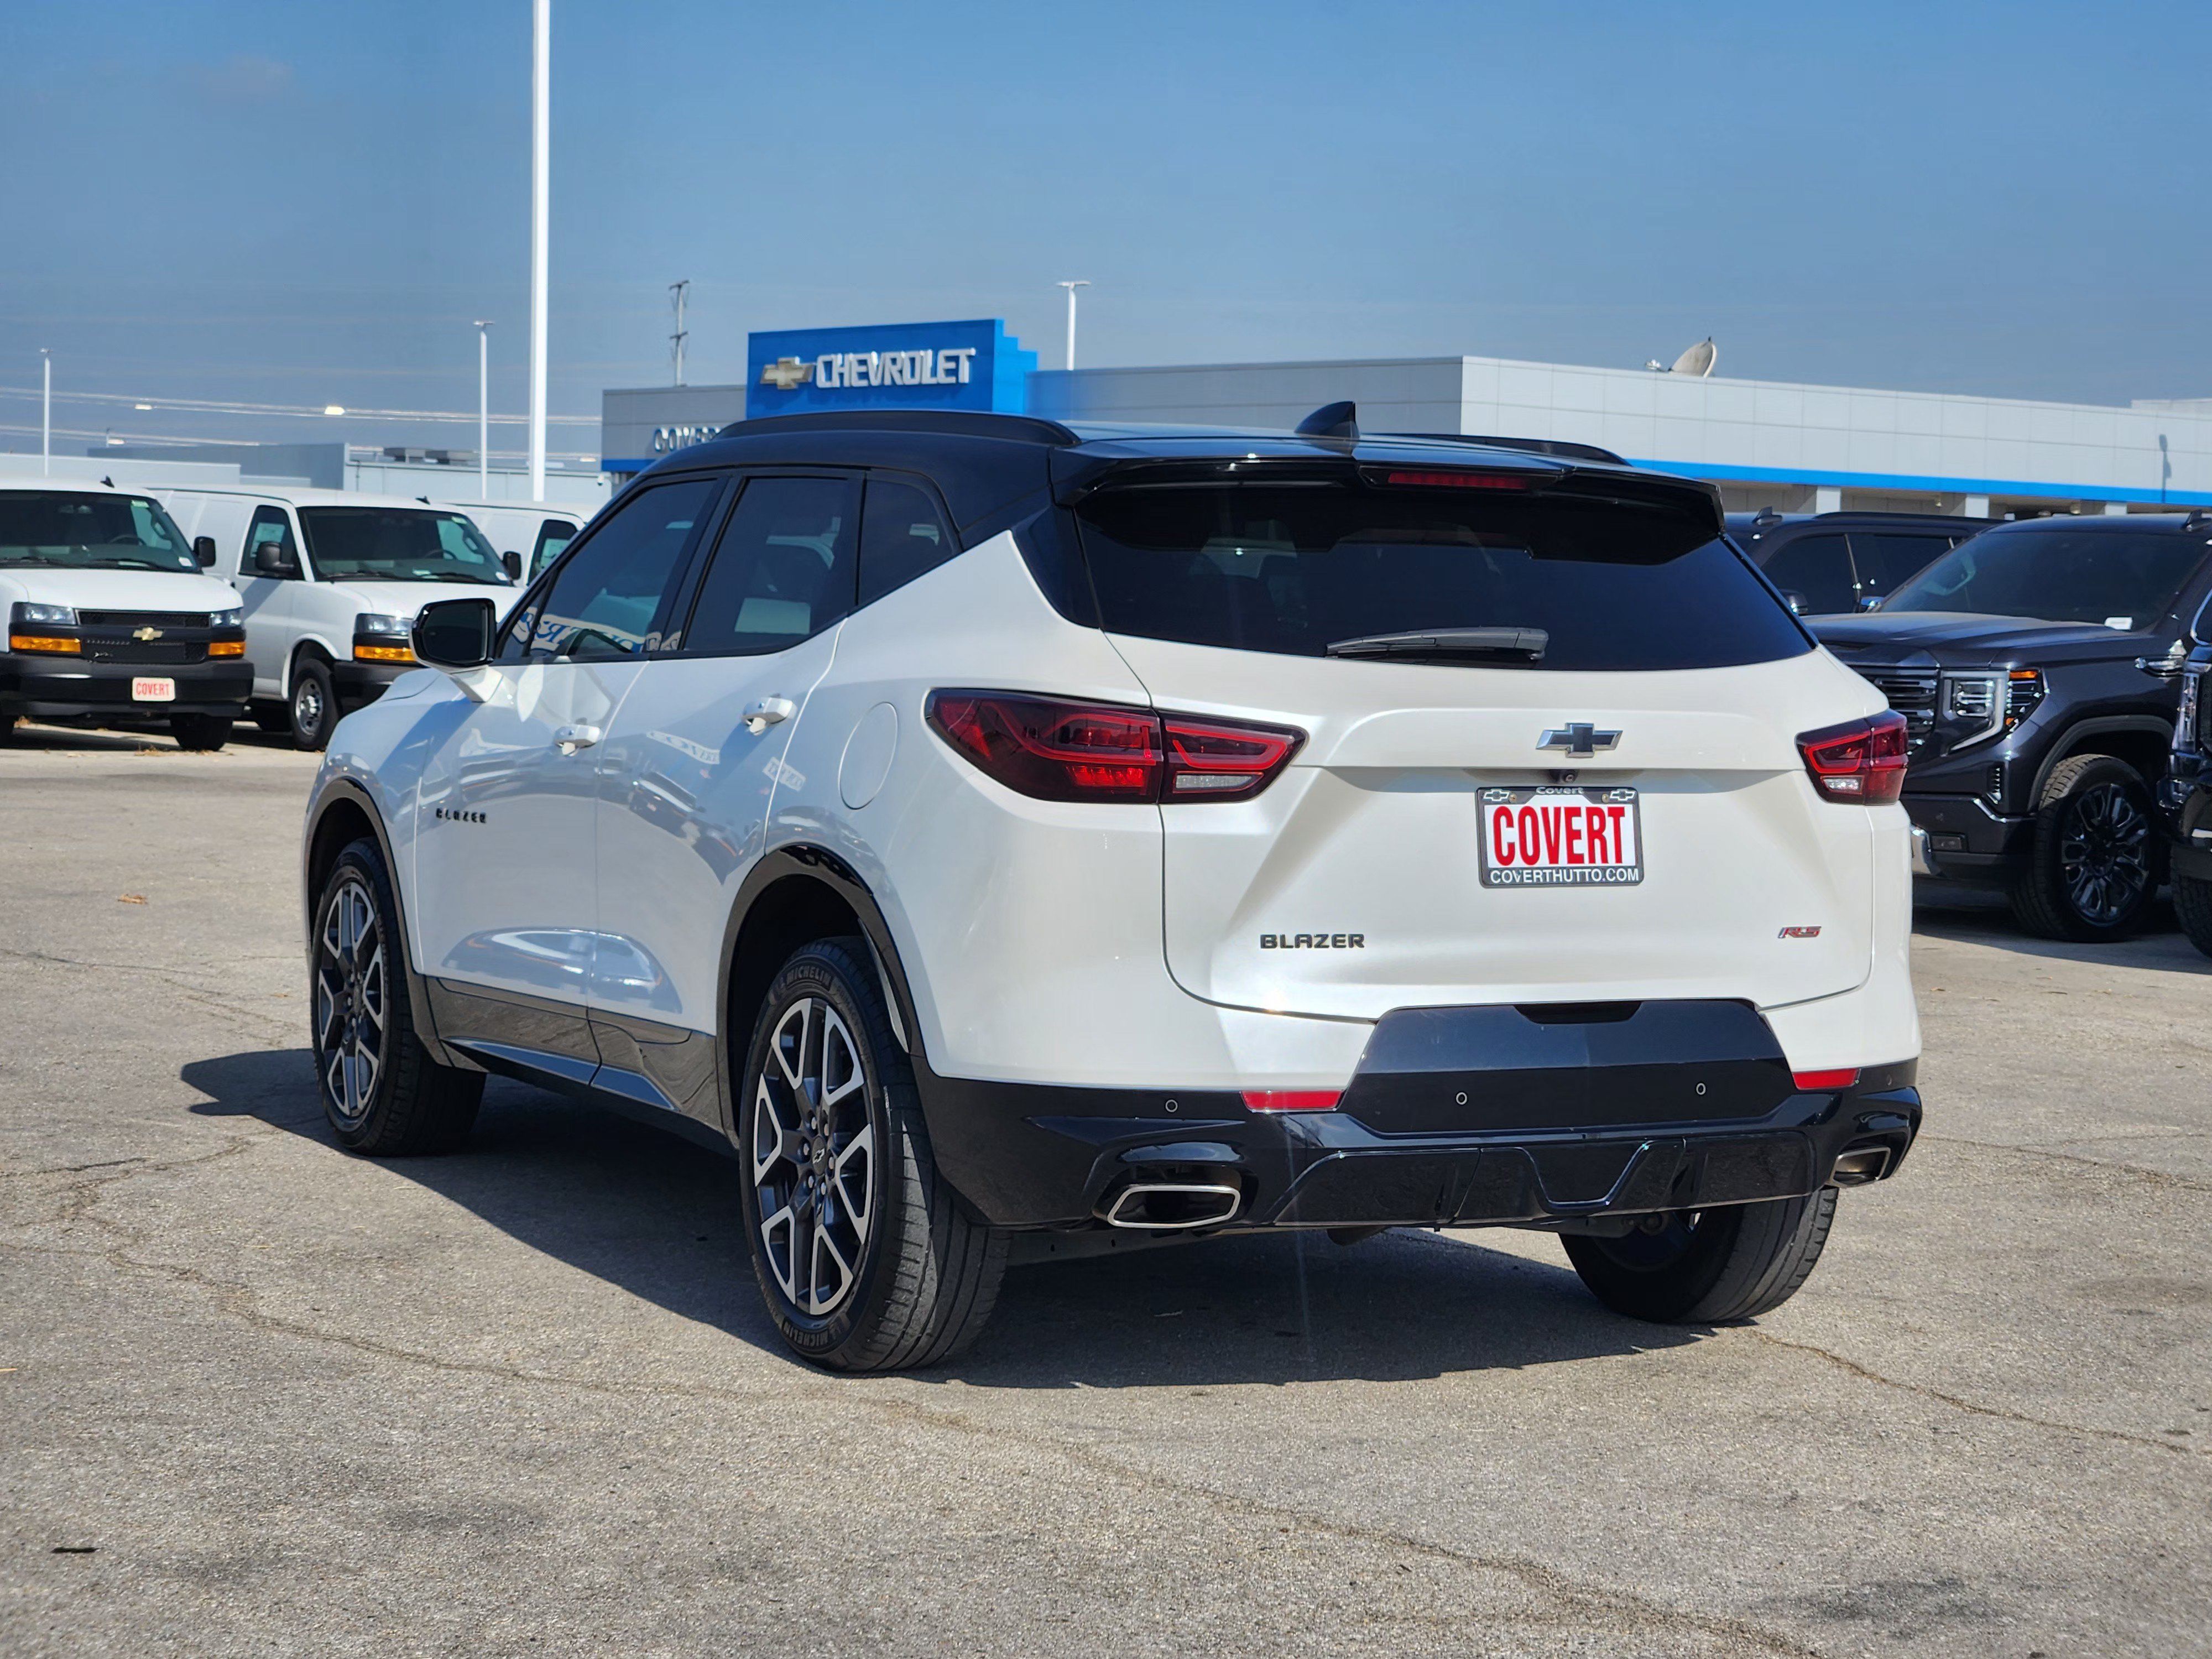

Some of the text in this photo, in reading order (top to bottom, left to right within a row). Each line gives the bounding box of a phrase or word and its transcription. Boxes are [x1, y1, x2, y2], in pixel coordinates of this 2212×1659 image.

[816, 347, 976, 388] CHEVROLET
[136, 682, 169, 696] COVERT
[1535, 786, 1584, 795] Covert
[435, 807, 487, 824] BLAZER
[1493, 806, 1625, 866] COVERT
[1490, 868, 1639, 884] COVERTHUTTO.COM
[1260, 933, 1365, 949] BLAZER
[786, 966, 832, 987] MICHELIN
[782, 1321, 829, 1347] MICHELIN
